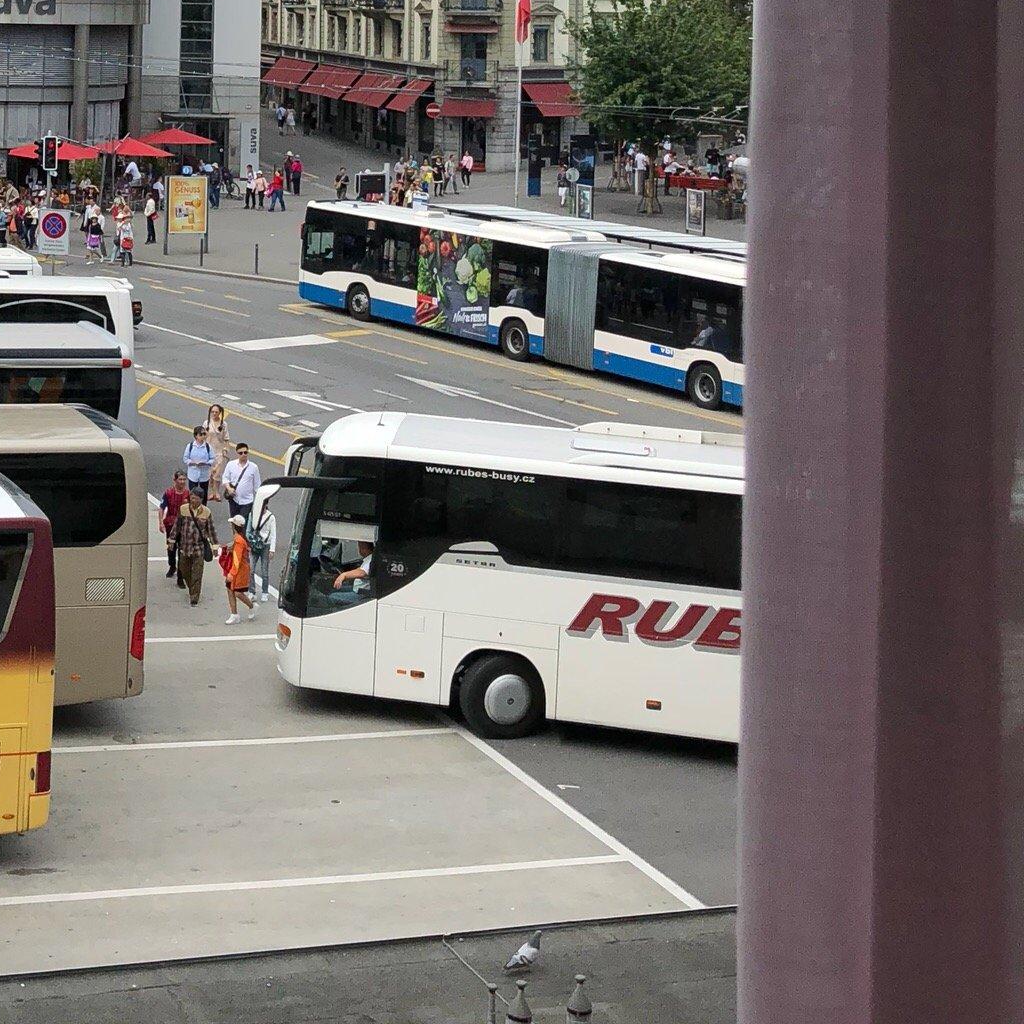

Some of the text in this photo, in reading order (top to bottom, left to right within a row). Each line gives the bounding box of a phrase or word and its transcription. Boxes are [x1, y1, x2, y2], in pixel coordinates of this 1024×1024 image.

[175, 186, 201, 194] GENUSS
[425, 466, 535, 483] www.rubes-busy.cz
[390, 563, 405, 573] 20
